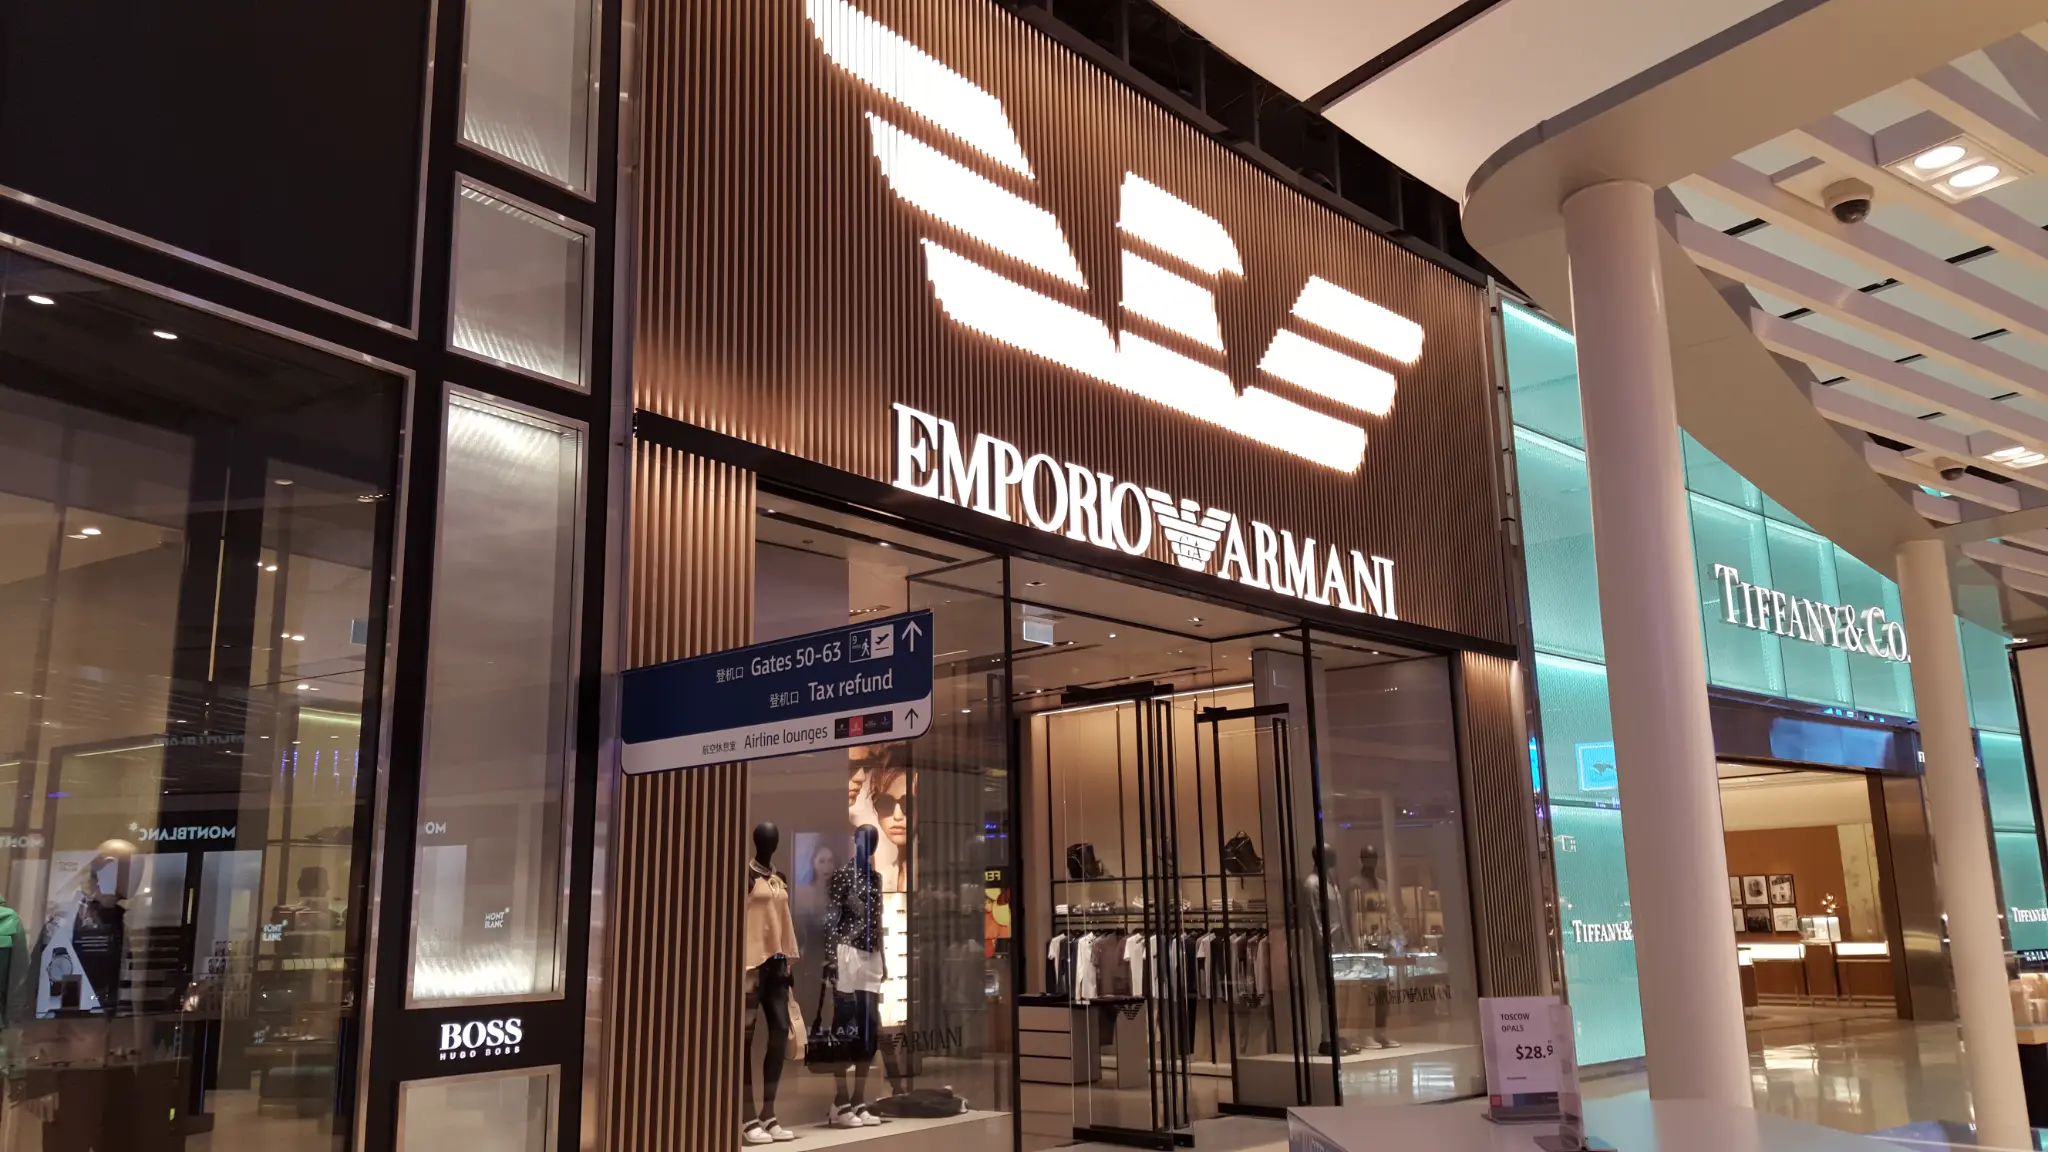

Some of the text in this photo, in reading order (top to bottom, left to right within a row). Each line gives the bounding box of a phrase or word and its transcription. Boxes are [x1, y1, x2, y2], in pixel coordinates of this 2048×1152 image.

[893, 402, 1399, 620] EMPORIO ARMANI
[852, 635, 858, 645] 9
[751, 641, 841, 676] Gates 50-63
[716, 666, 744, 684] 登机口
[808, 667, 893, 702] Tax refund
[769, 691, 799, 709] 登机口
[744, 726, 828, 749] Airline lounges
[439, 1018, 523, 1051] BOSS
[901, 1026, 963, 1050] ARMANI
[440, 1046, 520, 1061] HUGO BOSS
